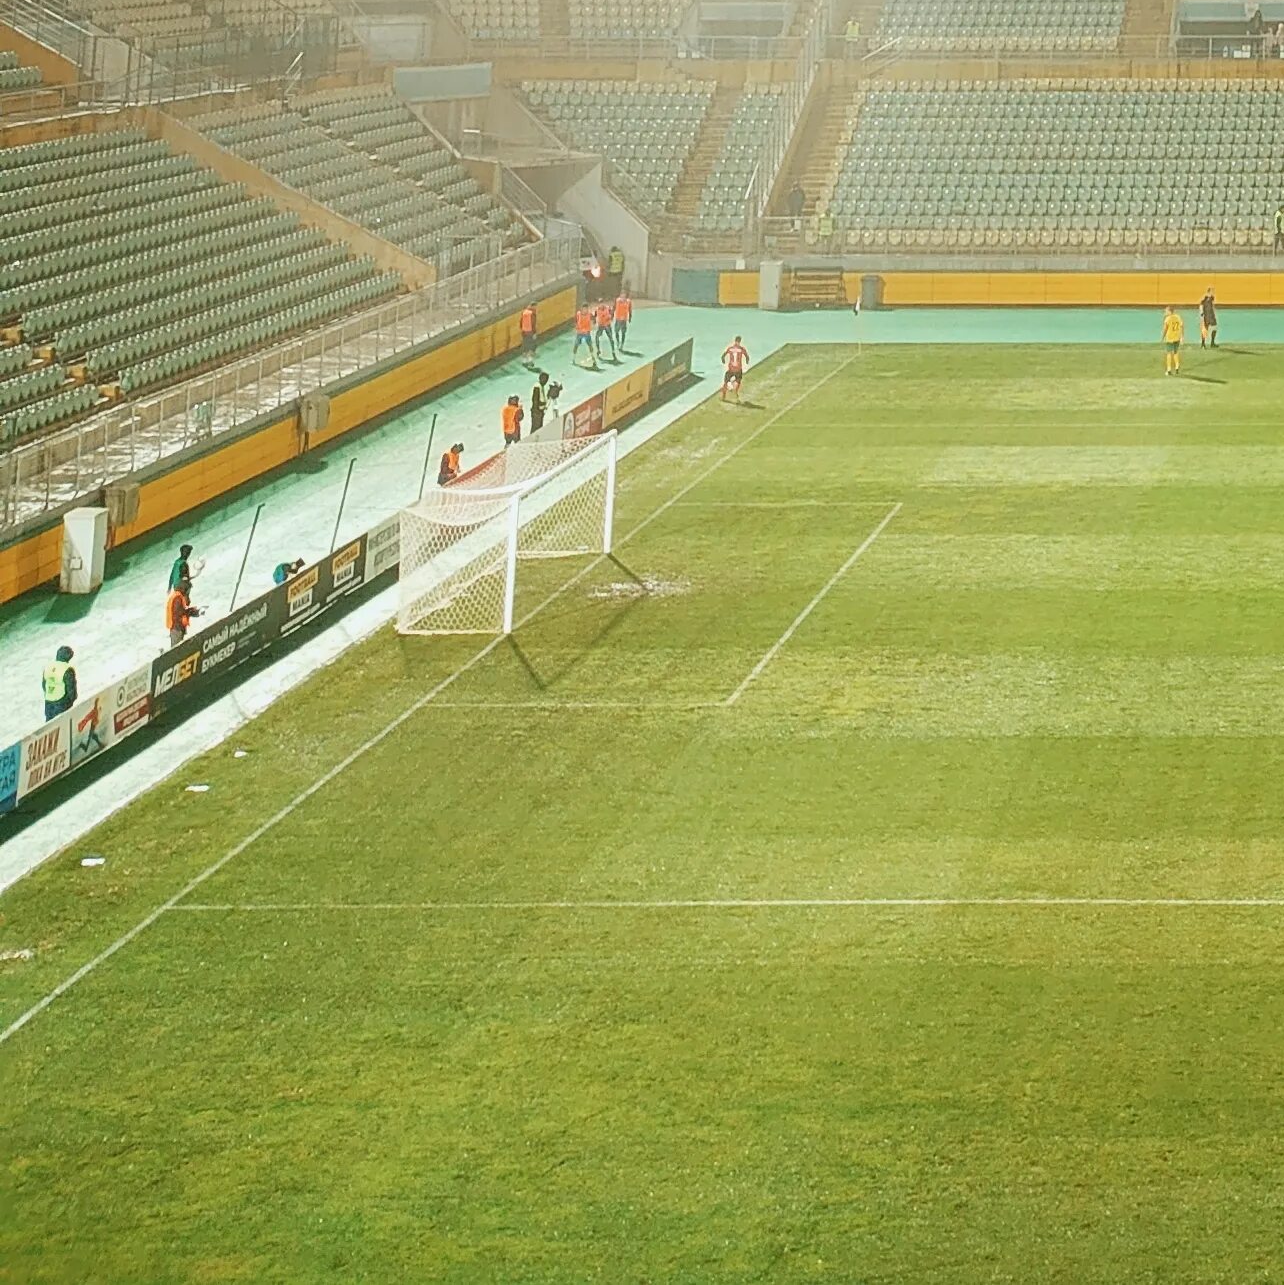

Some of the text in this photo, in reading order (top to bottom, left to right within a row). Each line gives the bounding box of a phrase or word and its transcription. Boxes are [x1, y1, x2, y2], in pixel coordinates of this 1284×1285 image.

[201, 641, 236, 675] БУКМЕКЕР
[202, 624, 229, 654] САМЫЙ
[154, 651, 200, 698] МЕЛБЕТ
[26, 727, 61, 771] ЗАКАЖИ
